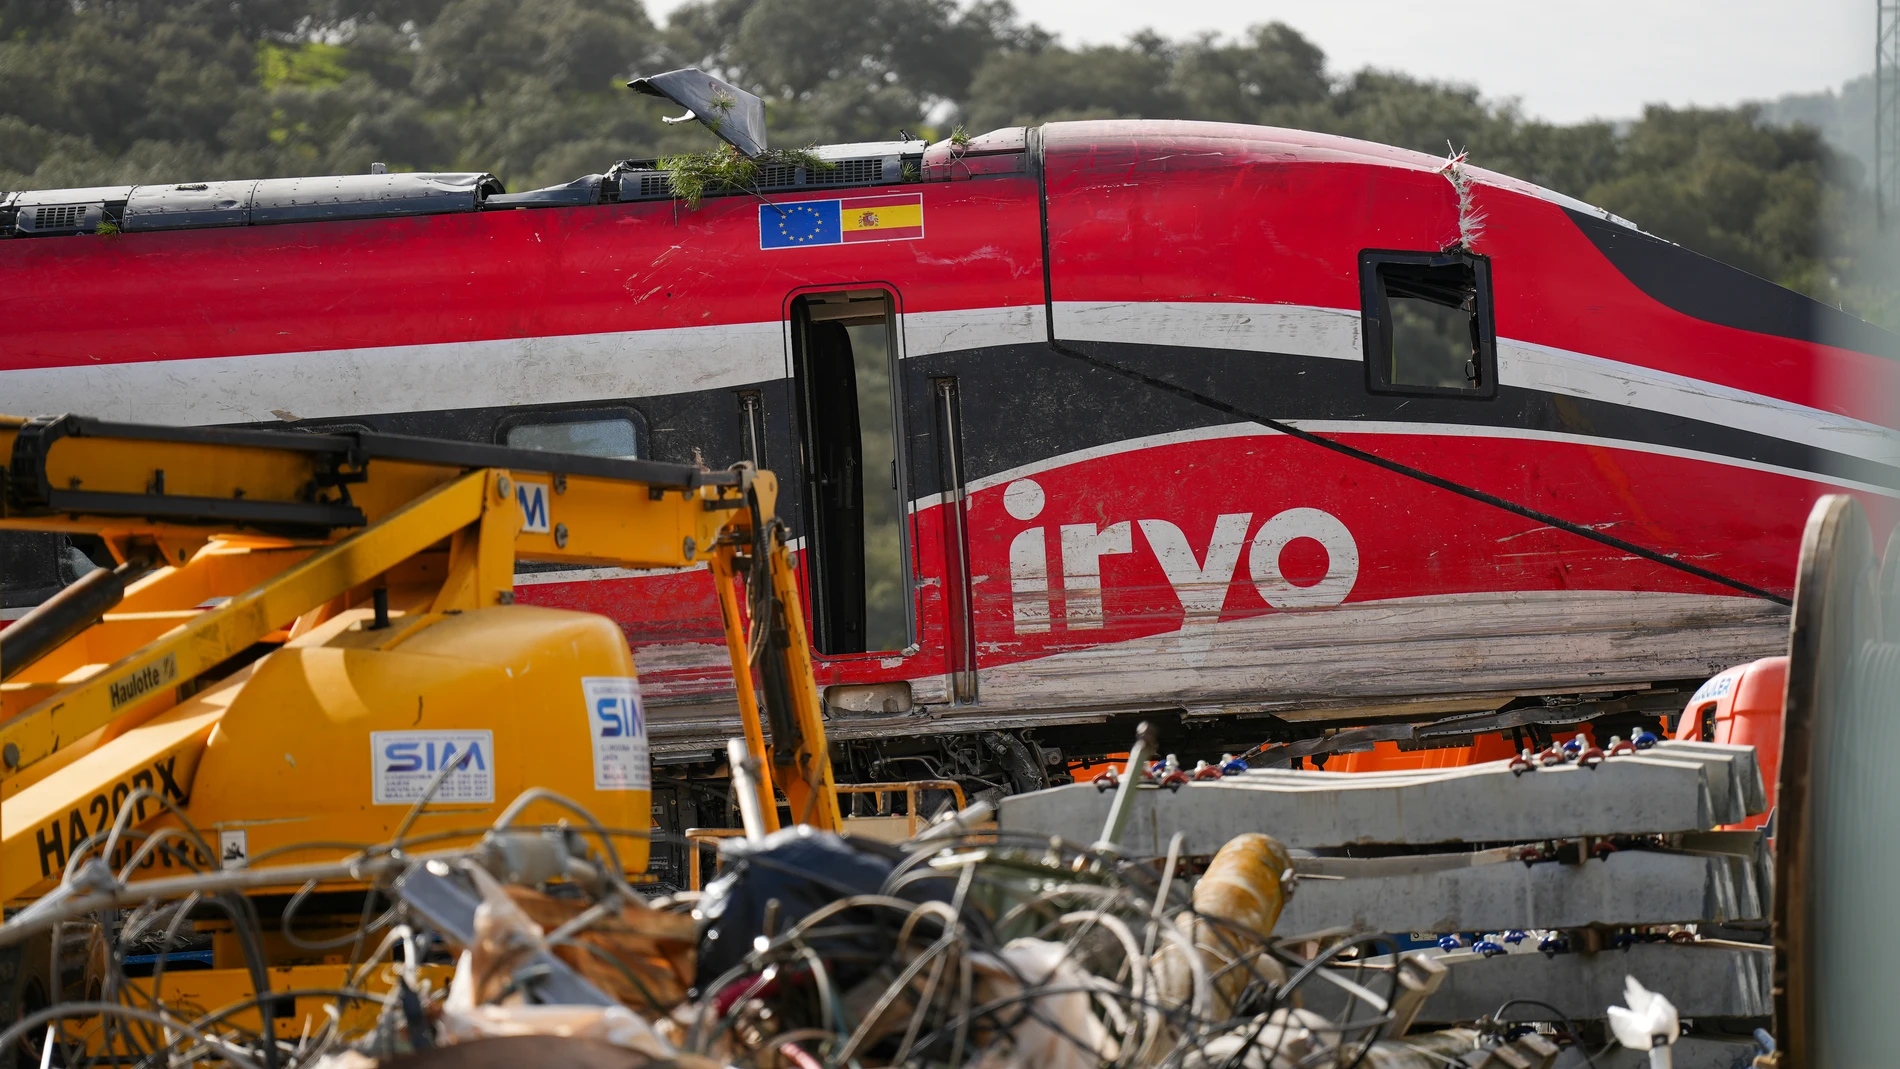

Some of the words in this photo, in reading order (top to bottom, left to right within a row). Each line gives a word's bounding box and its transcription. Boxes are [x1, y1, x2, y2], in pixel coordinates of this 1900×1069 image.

[110, 666, 160, 708] Haulotte
[384, 742, 485, 772] SIM
[36, 756, 186, 877] HA20PX
